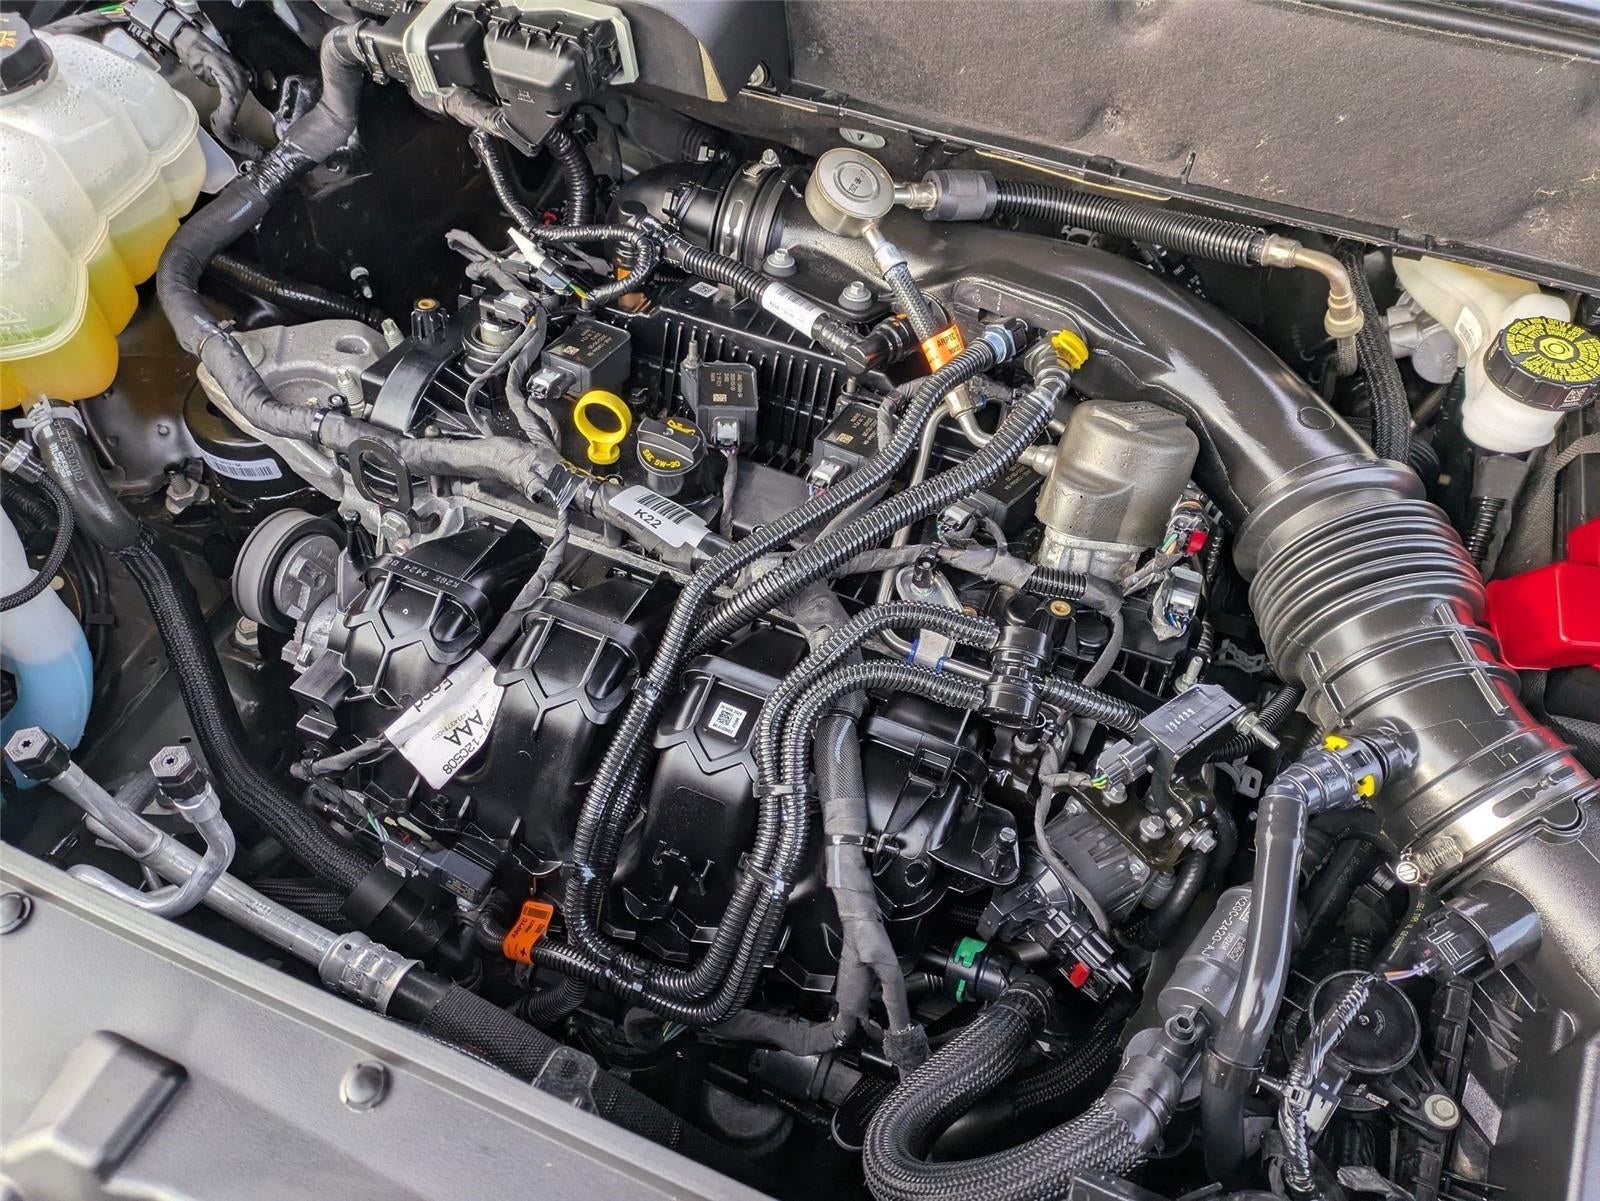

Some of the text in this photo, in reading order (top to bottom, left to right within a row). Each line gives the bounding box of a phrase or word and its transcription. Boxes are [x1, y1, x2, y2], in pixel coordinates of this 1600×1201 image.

[642, 448, 681, 469] SAE 5W-30
[633, 508, 662, 529] K22
[443, 709, 484, 746] AAA
